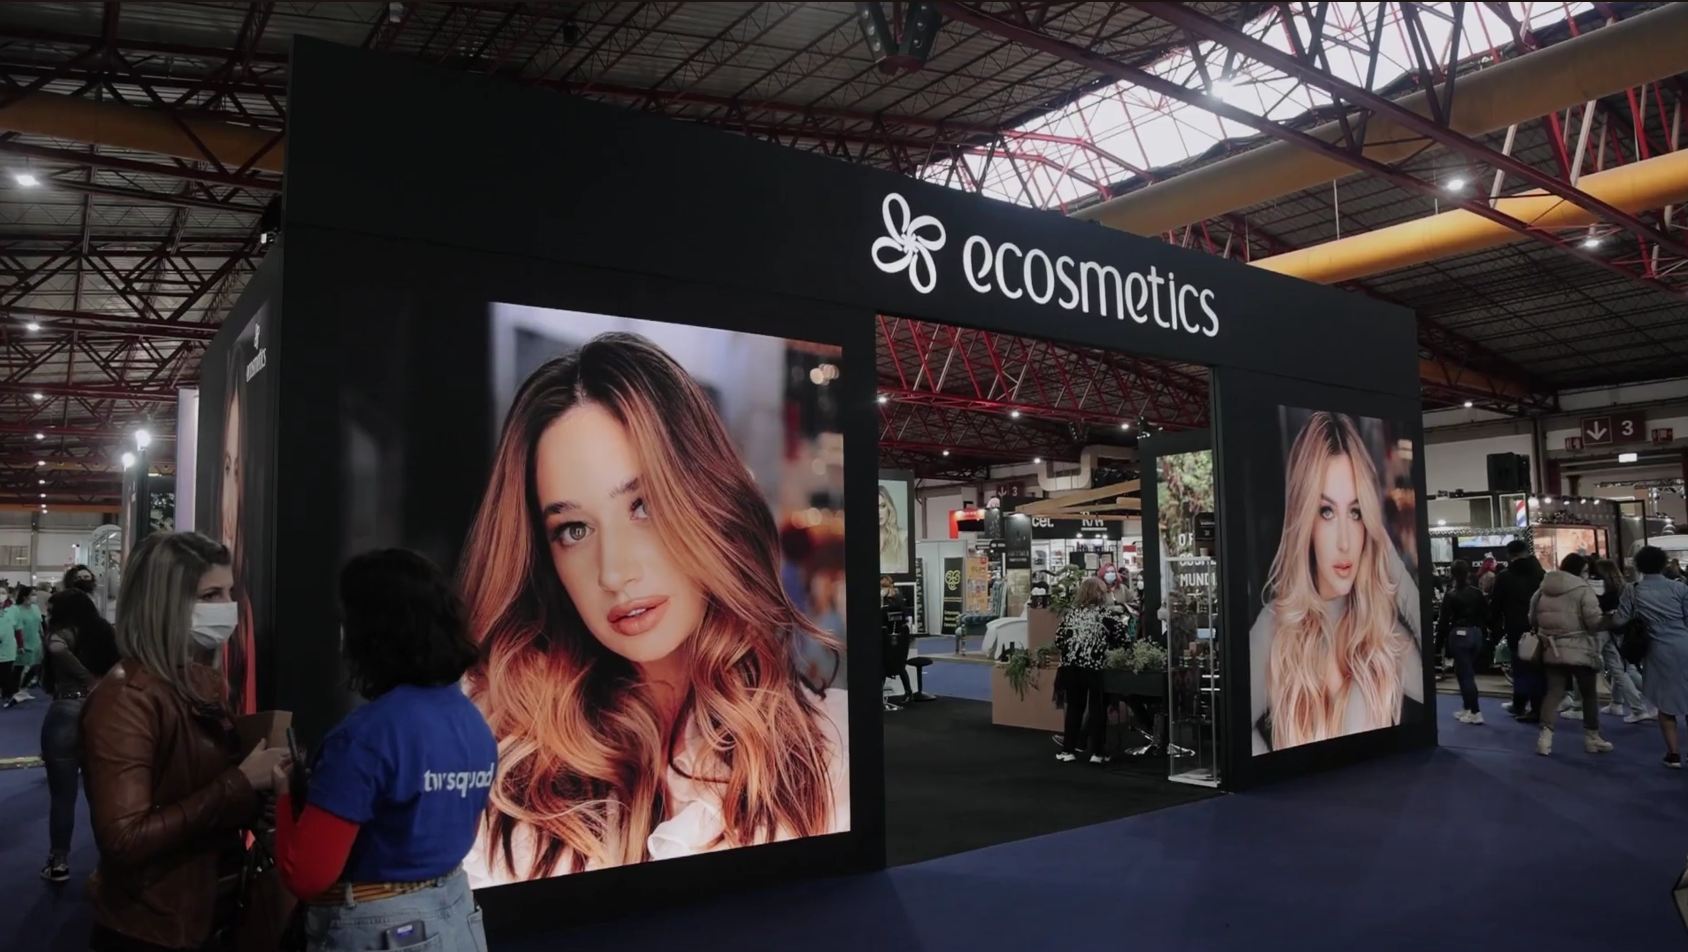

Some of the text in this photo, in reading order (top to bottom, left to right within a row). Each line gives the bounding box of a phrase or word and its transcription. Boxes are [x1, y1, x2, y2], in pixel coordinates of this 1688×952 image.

[962, 234, 1219, 337] ecosmetics
[1621, 419, 1634, 436] 3
[1012, 486, 1018, 497] 3
